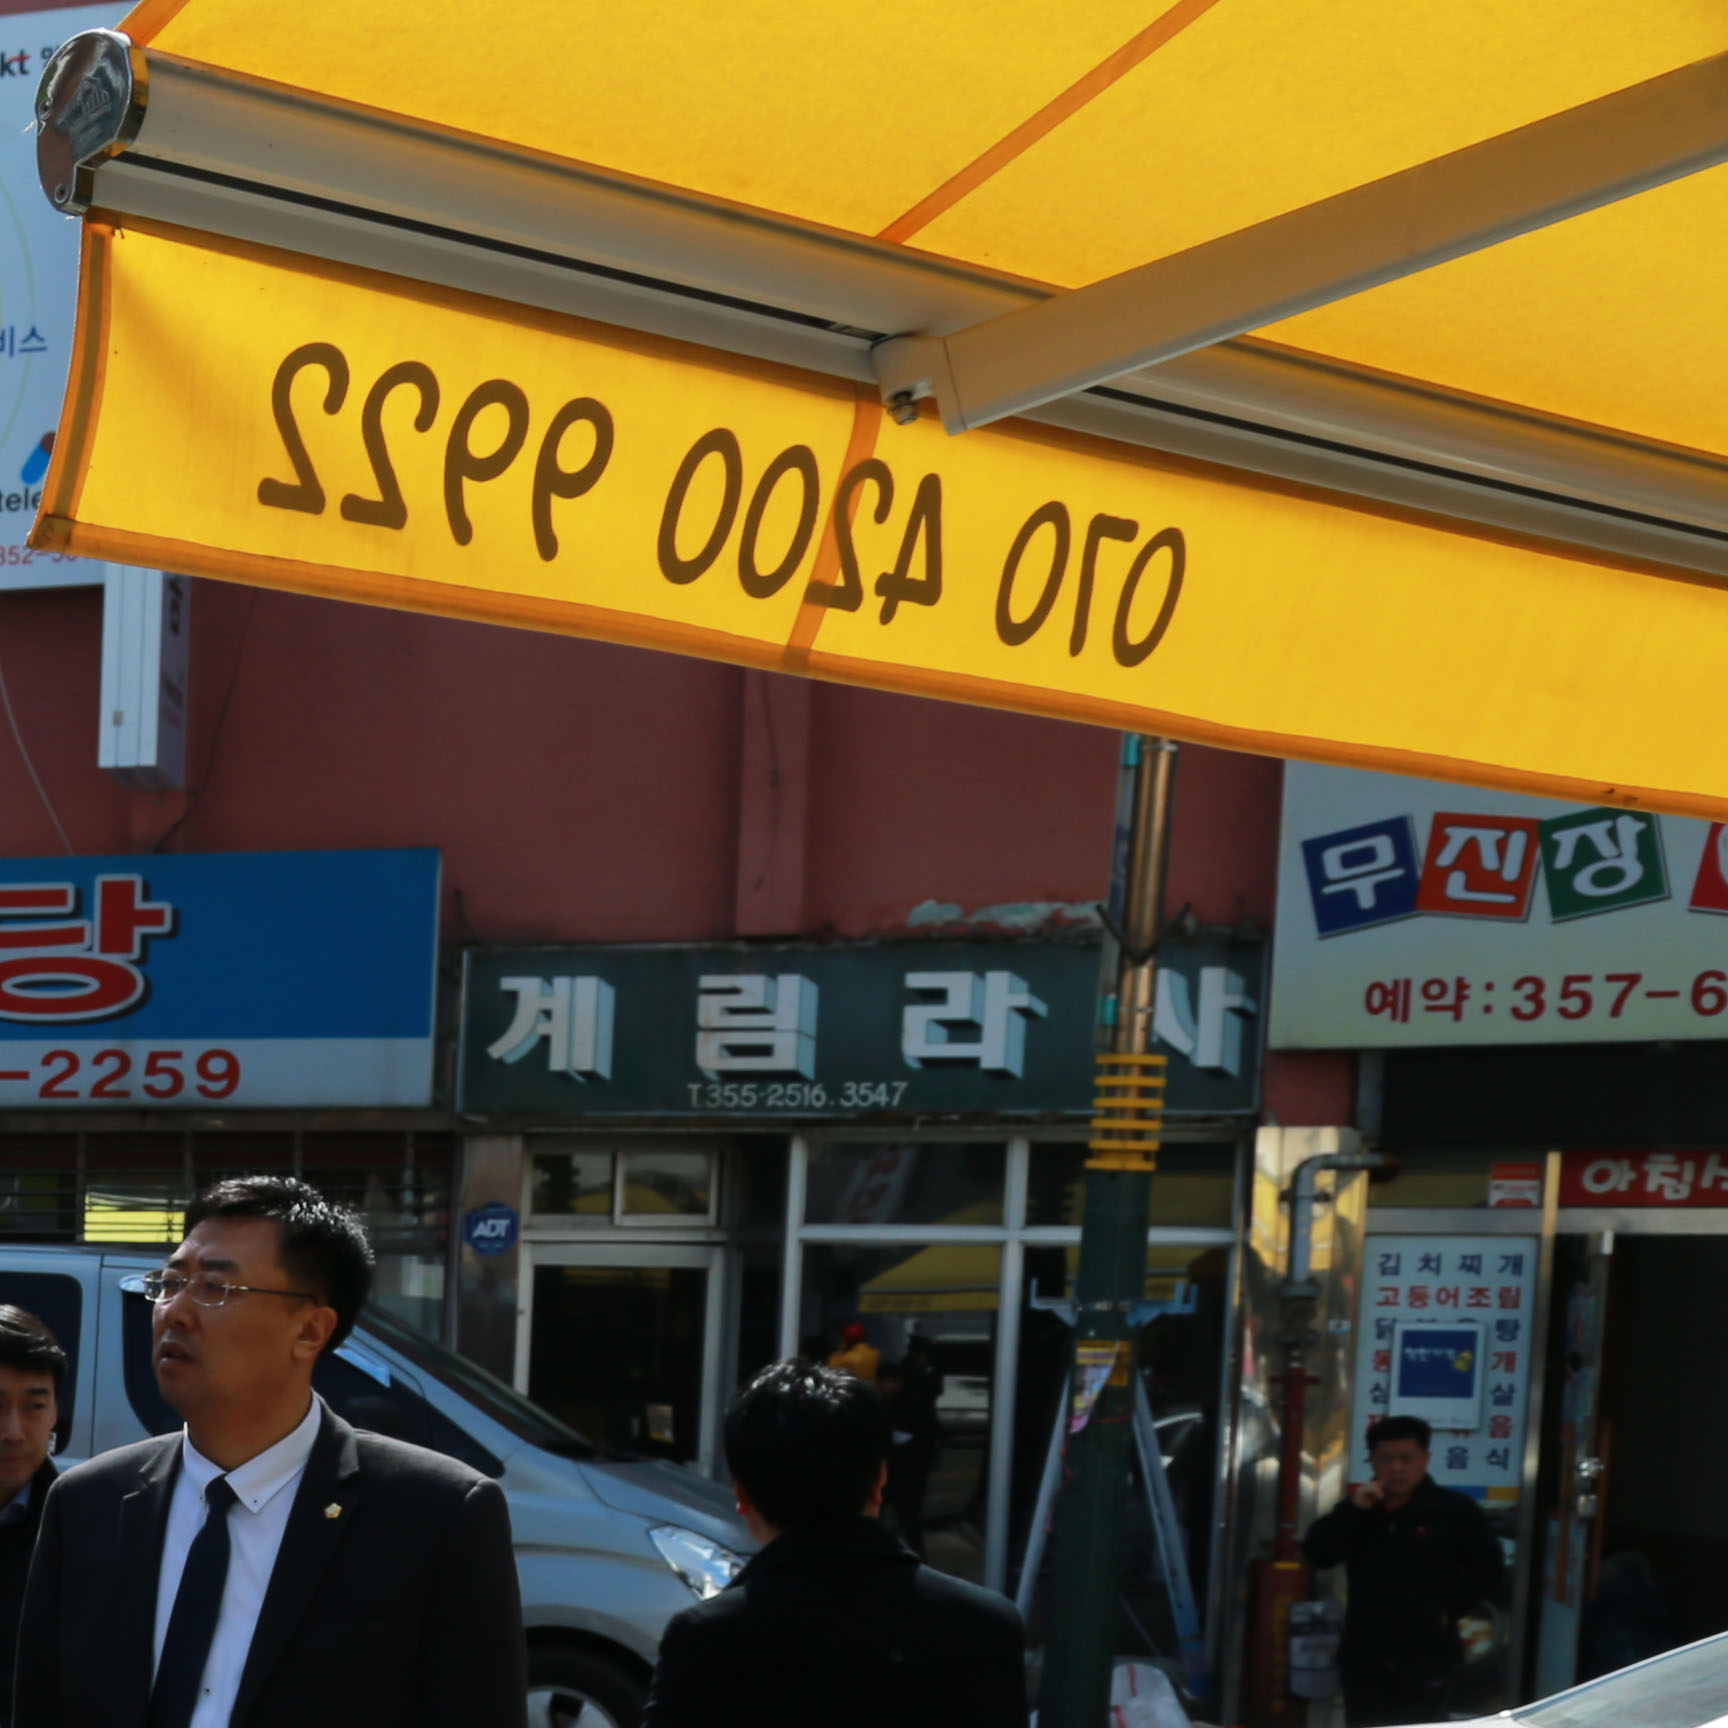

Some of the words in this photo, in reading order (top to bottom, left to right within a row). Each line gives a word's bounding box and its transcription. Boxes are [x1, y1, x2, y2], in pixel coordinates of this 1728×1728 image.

[0, 50, 32, 77] kt
[1320, 814, 1647, 910] 무진장
[471, 1217, 513, 1240] ADT
[1377, 1252, 1525, 1277] 김치찌개
[1375, 1285, 1523, 1310] 고등어조림
